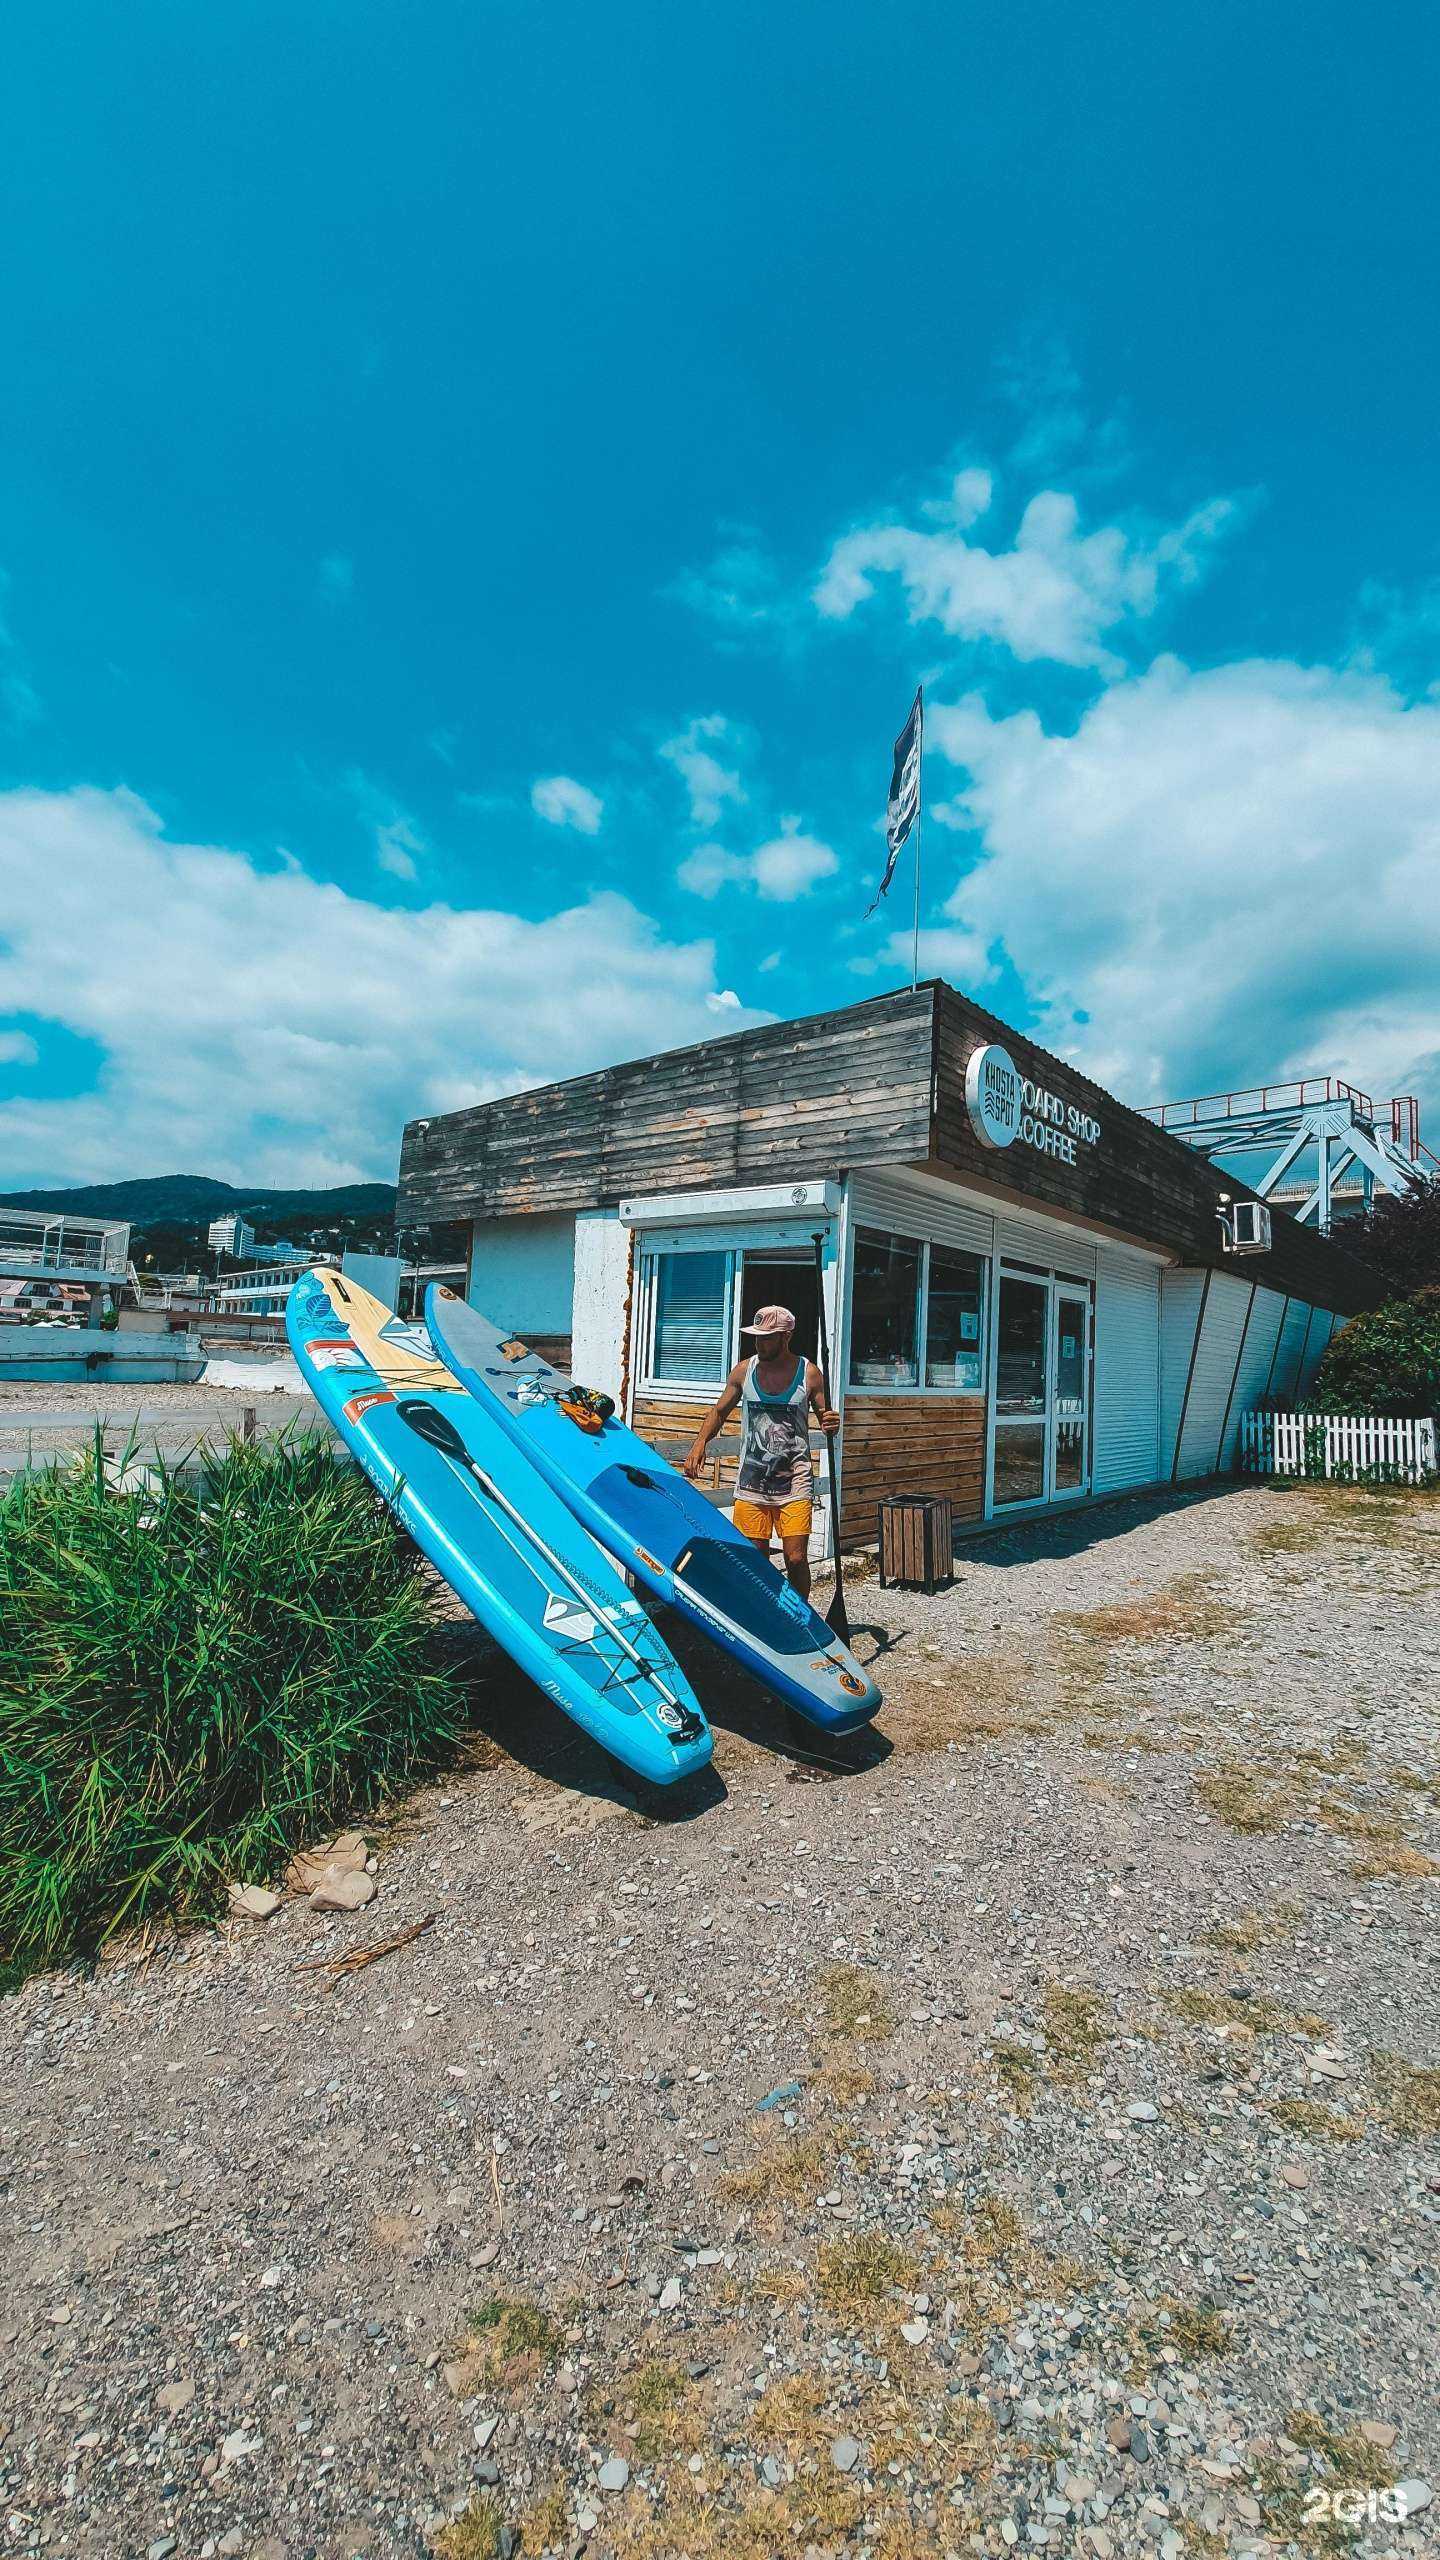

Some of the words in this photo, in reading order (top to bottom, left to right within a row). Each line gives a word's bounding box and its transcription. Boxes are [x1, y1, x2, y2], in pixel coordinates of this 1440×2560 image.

[985, 1060, 1015, 1102] KHOSTA
[995, 1094, 1015, 1129] SPOT
[1067, 1105, 1101, 1147] SHOP
[541, 1679, 573, 1710] Muse
